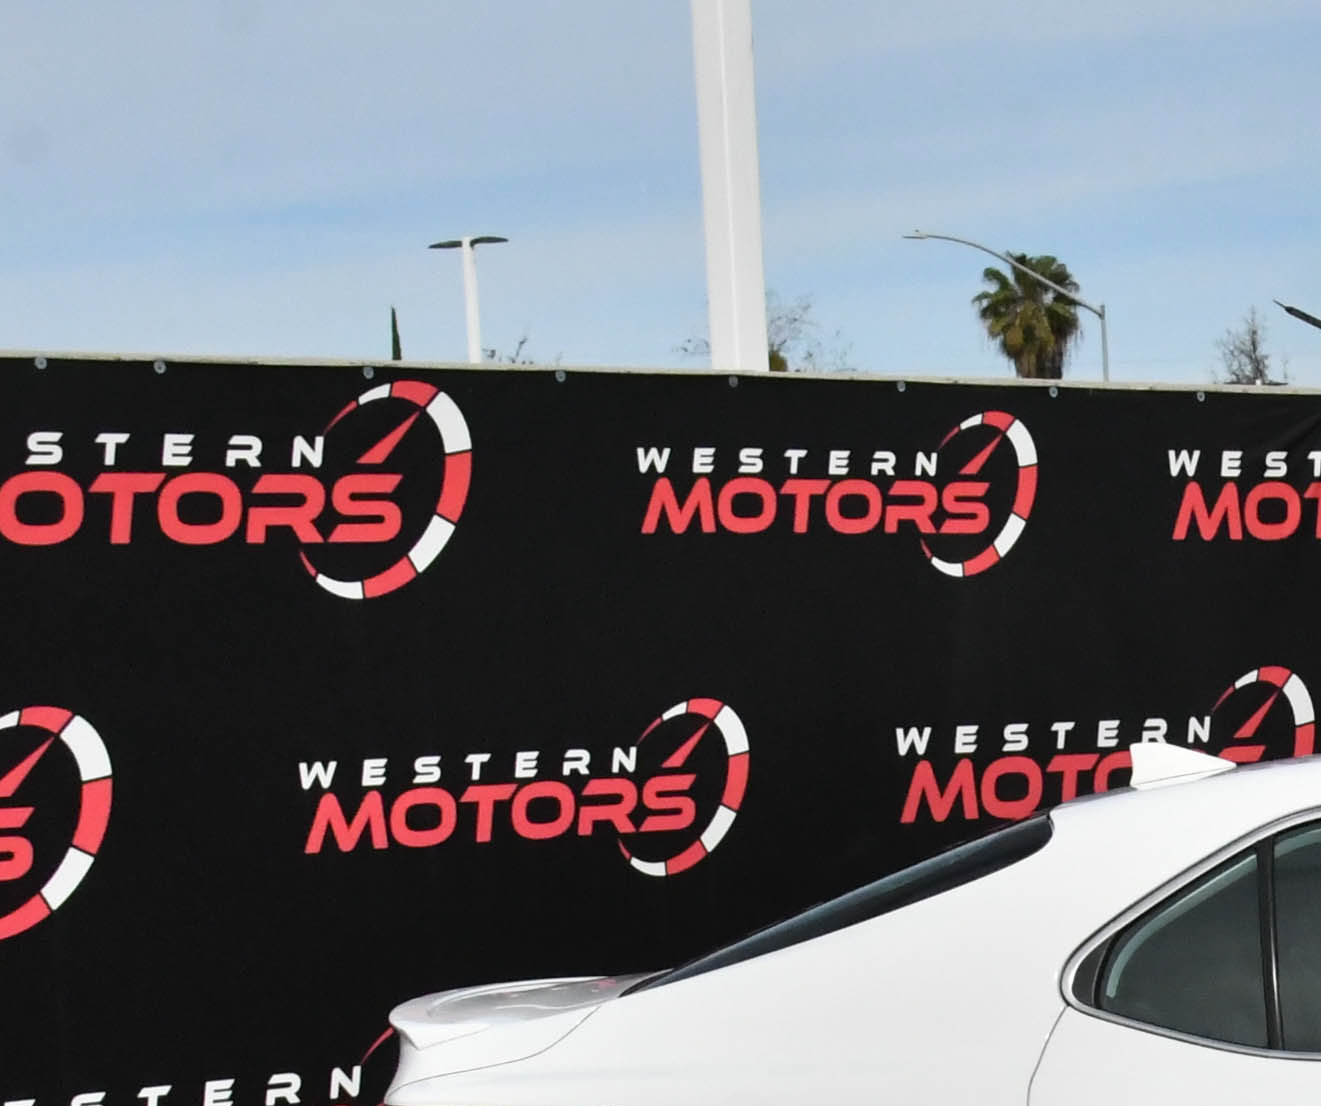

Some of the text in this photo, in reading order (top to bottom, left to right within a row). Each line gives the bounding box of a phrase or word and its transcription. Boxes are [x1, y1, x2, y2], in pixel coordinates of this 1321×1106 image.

[26, 431, 325, 468] STERN
[636, 446, 938, 477] WESTERN
[0, 471, 403, 545] OTORS
[641, 476, 990, 535] MOTORS
[896, 715, 1212, 757] WESTERN
[298, 746, 638, 791] WESTERN
[304, 773, 697, 854] MOTORS
